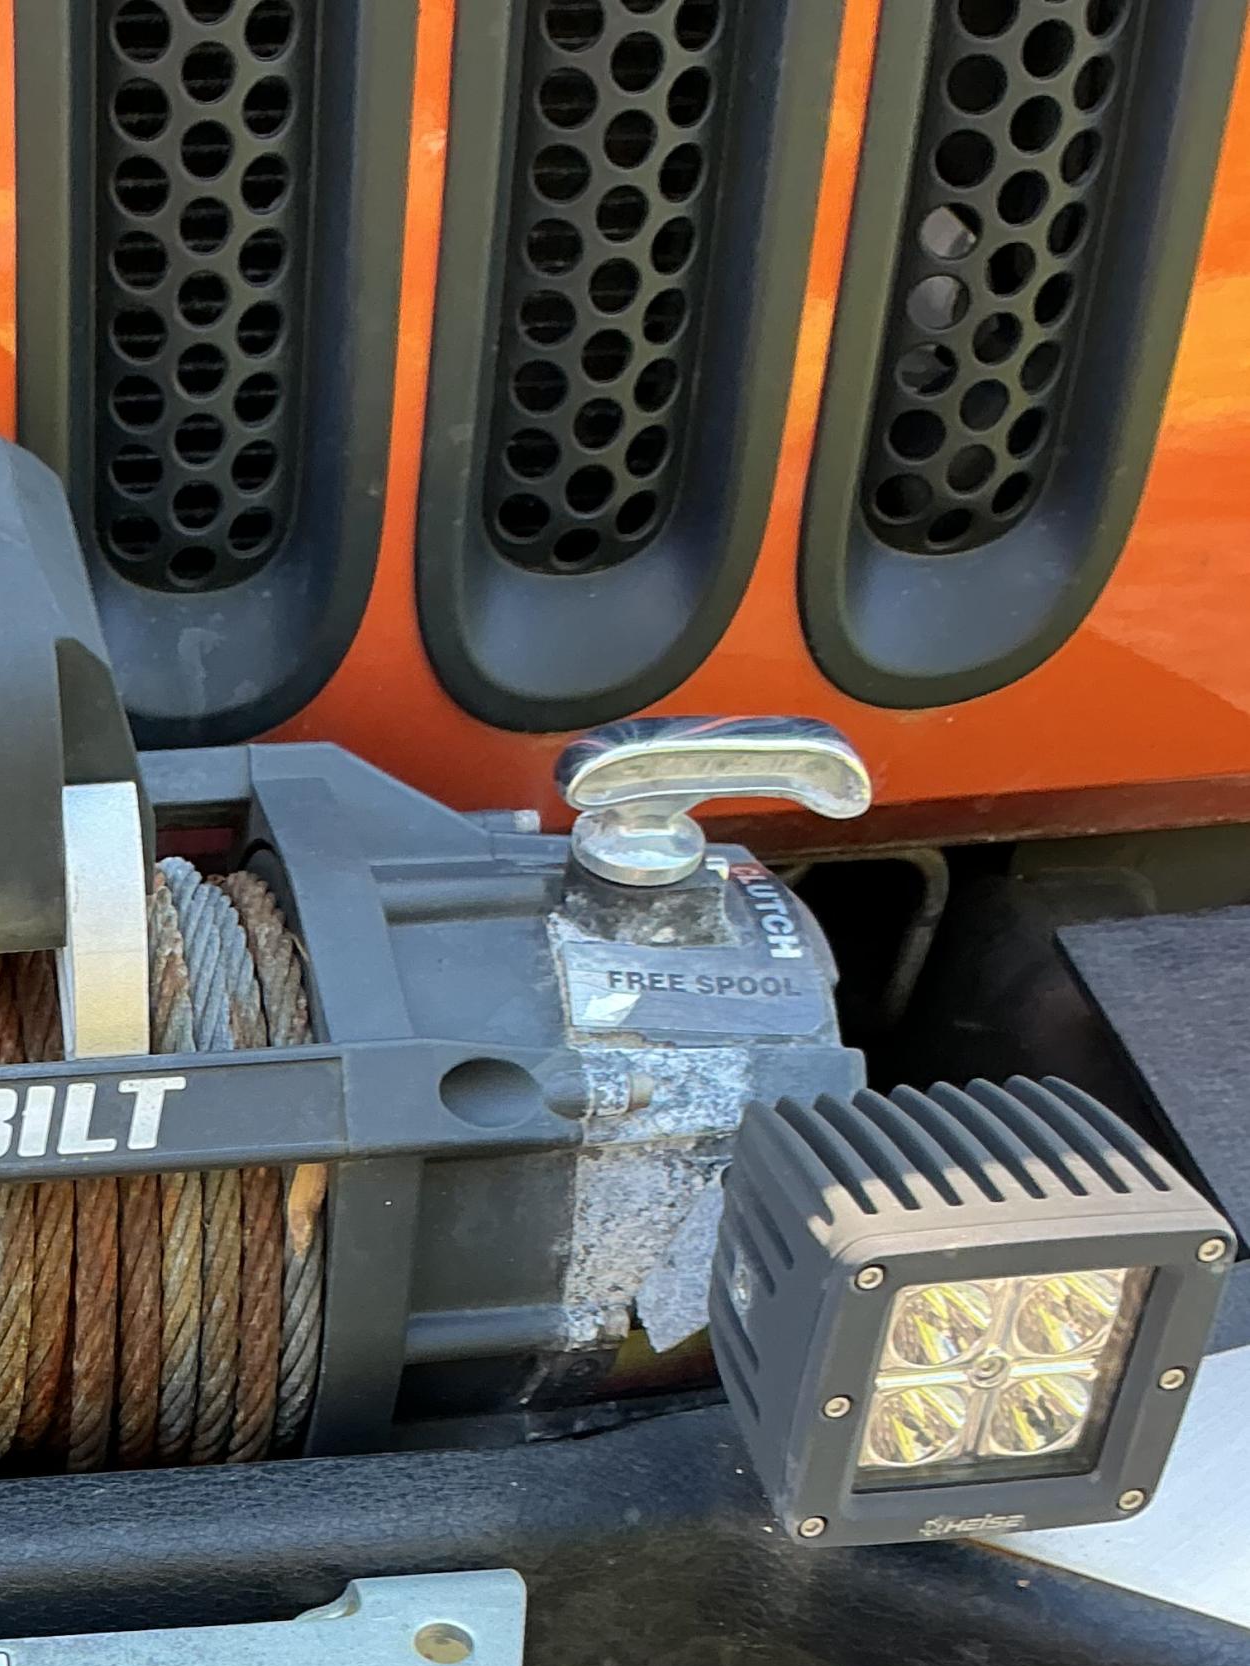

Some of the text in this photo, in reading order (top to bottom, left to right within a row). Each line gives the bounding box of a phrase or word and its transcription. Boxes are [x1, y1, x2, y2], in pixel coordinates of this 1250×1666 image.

[731, 866, 803, 958] CLUTCH
[607, 970, 801, 997] FREE SPOOL
